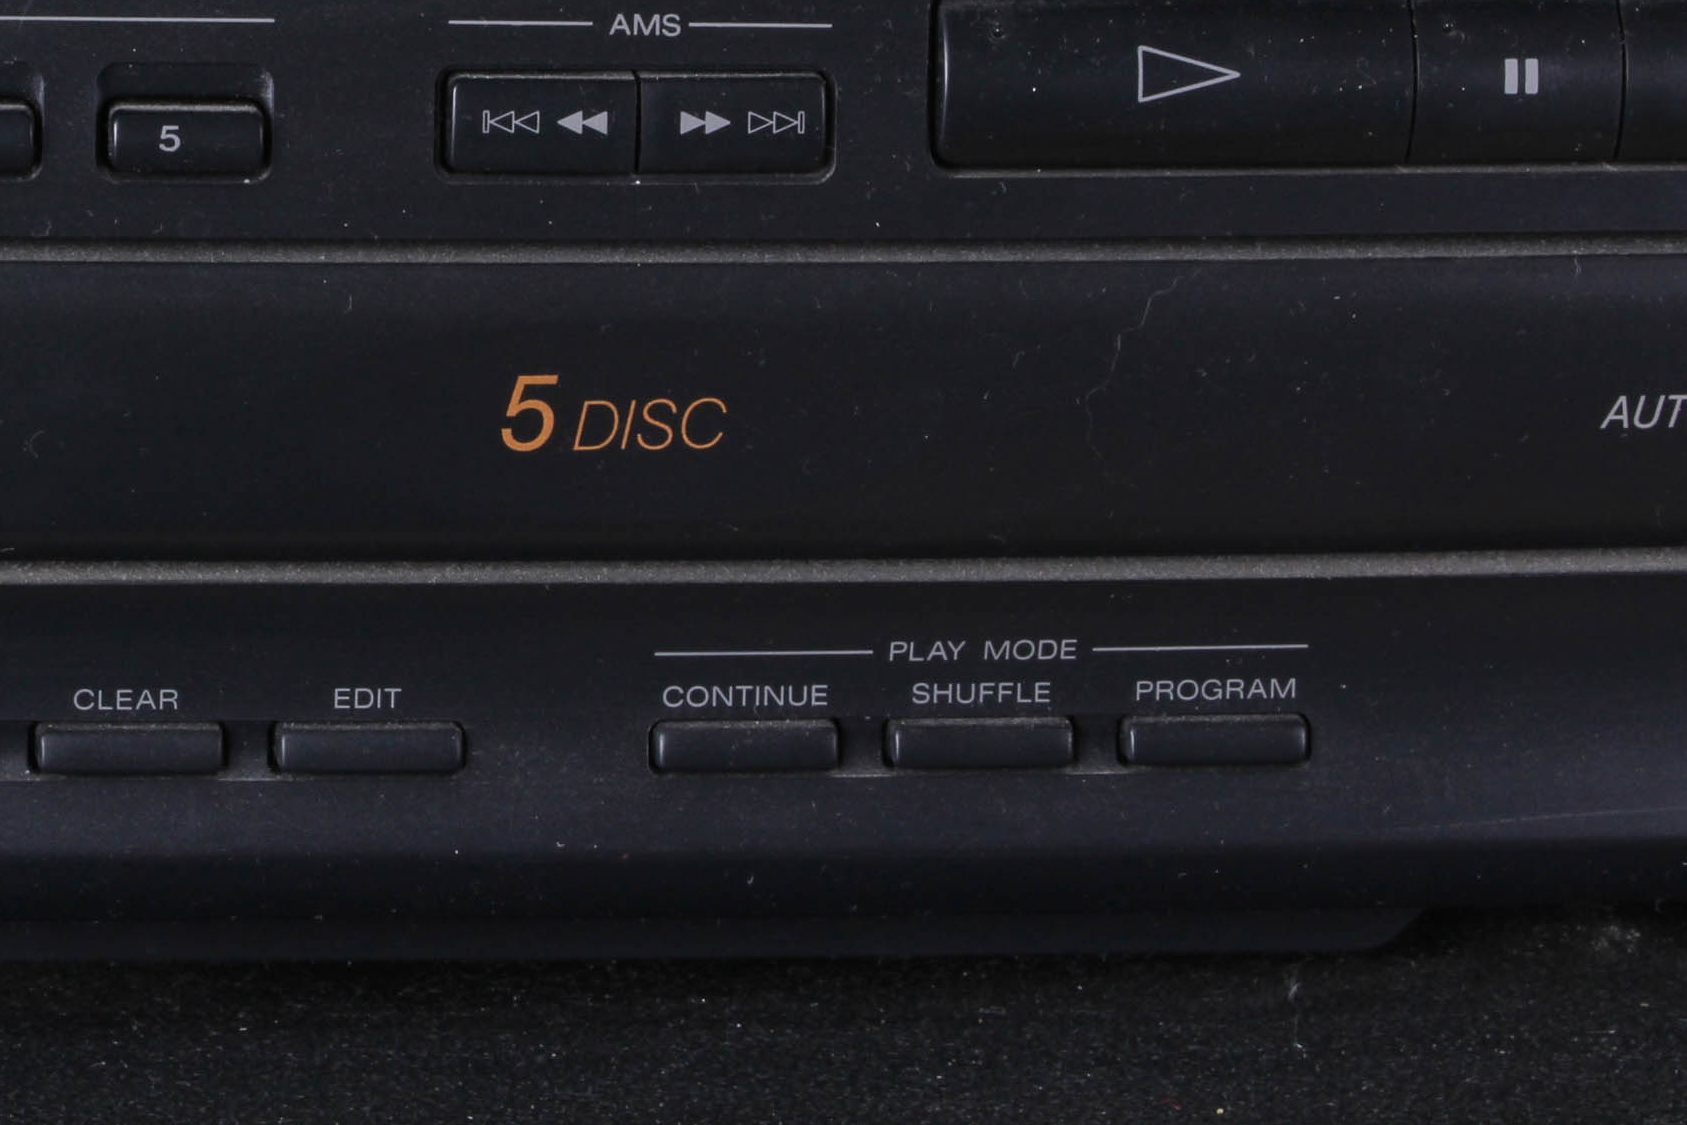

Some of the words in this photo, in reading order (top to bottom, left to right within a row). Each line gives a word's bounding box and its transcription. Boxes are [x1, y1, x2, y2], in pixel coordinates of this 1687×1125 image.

[609, 13, 682, 37] AMS
[158, 125, 181, 153] 5
[501, 374, 559, 452] 5
[572, 397, 728, 451] DISC
[889, 640, 966, 662] PLAY
[983, 639, 1078, 661] MODE
[73, 688, 179, 711] CLEAR
[334, 687, 402, 709] EDIT
[662, 684, 829, 708] CONTINUE
[912, 681, 1051, 705] SHUFFLE
[1136, 677, 1296, 701] PROGRAM
